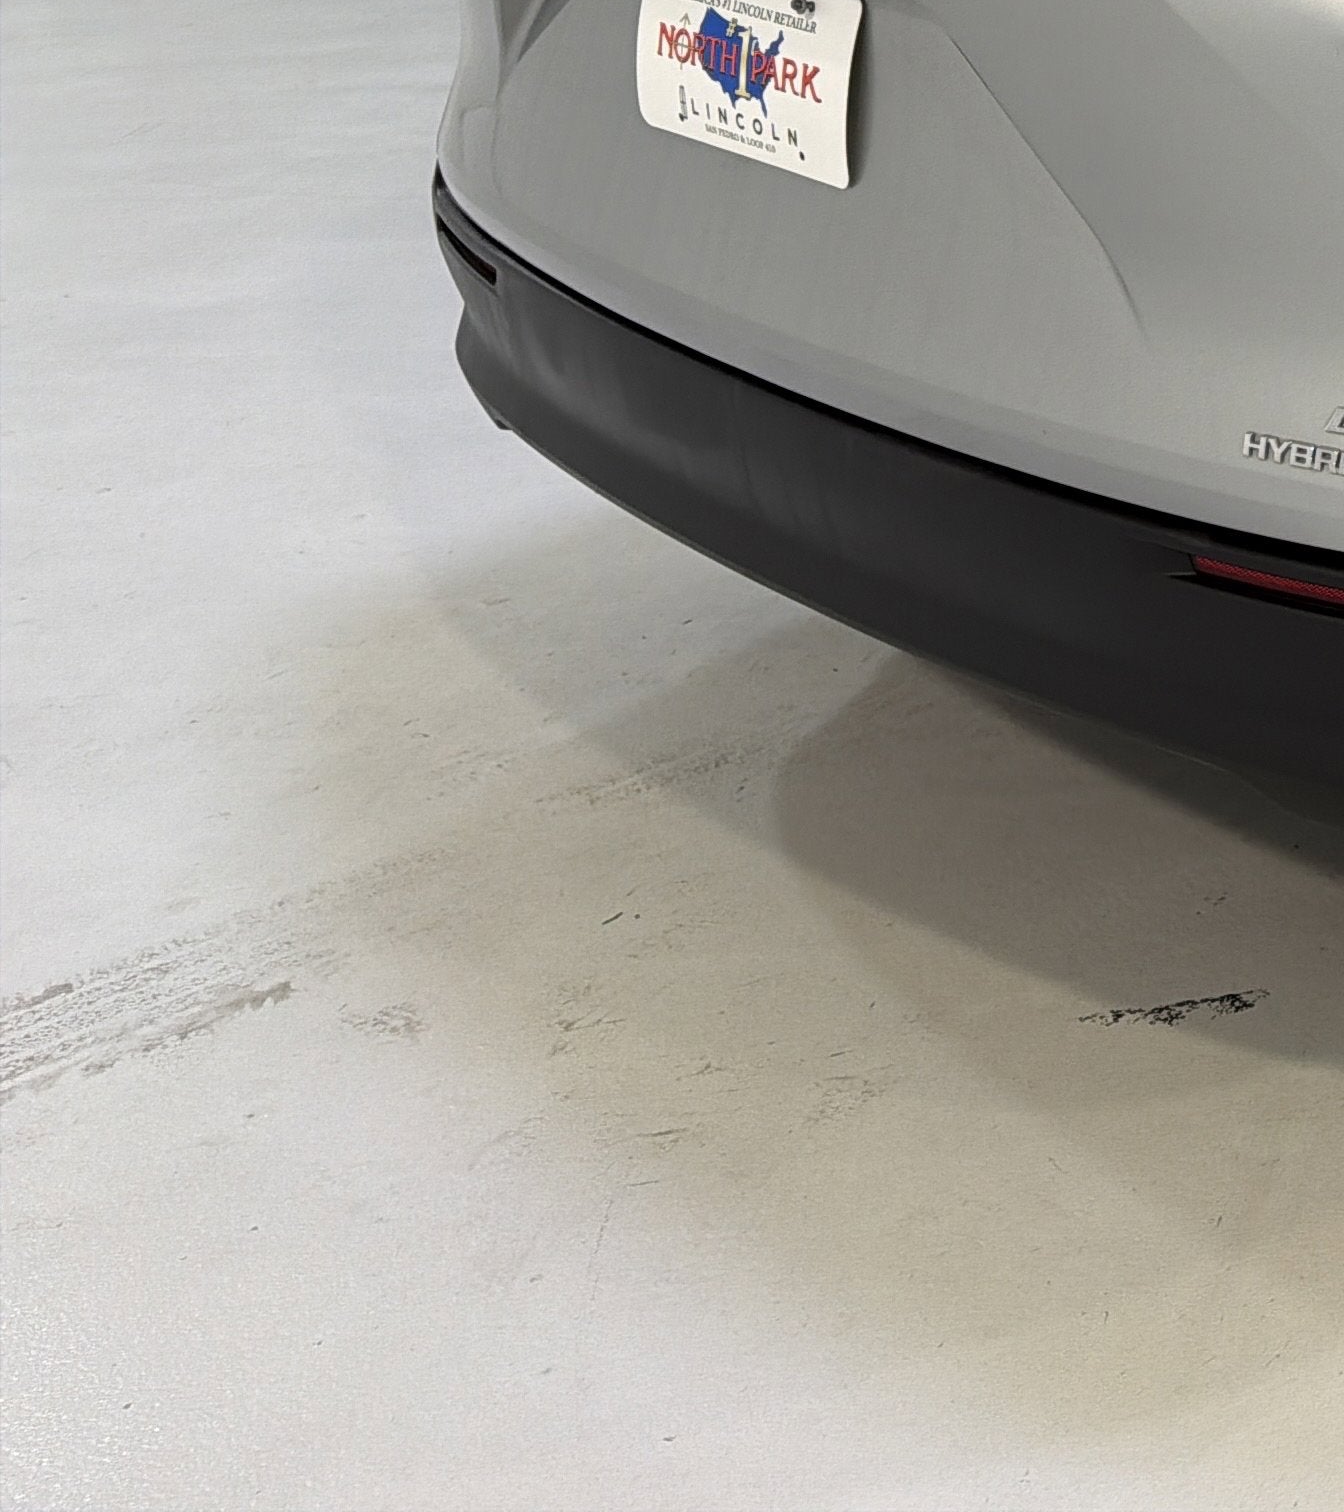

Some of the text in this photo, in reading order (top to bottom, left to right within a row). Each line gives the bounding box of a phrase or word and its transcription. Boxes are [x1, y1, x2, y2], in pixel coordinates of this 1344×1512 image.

[732, 0, 774, 22] LINCOLN
[774, 11, 818, 35] RETAILER
[657, 22, 823, 104] NORTH PARK
[691, 97, 799, 148] LINCOLN
